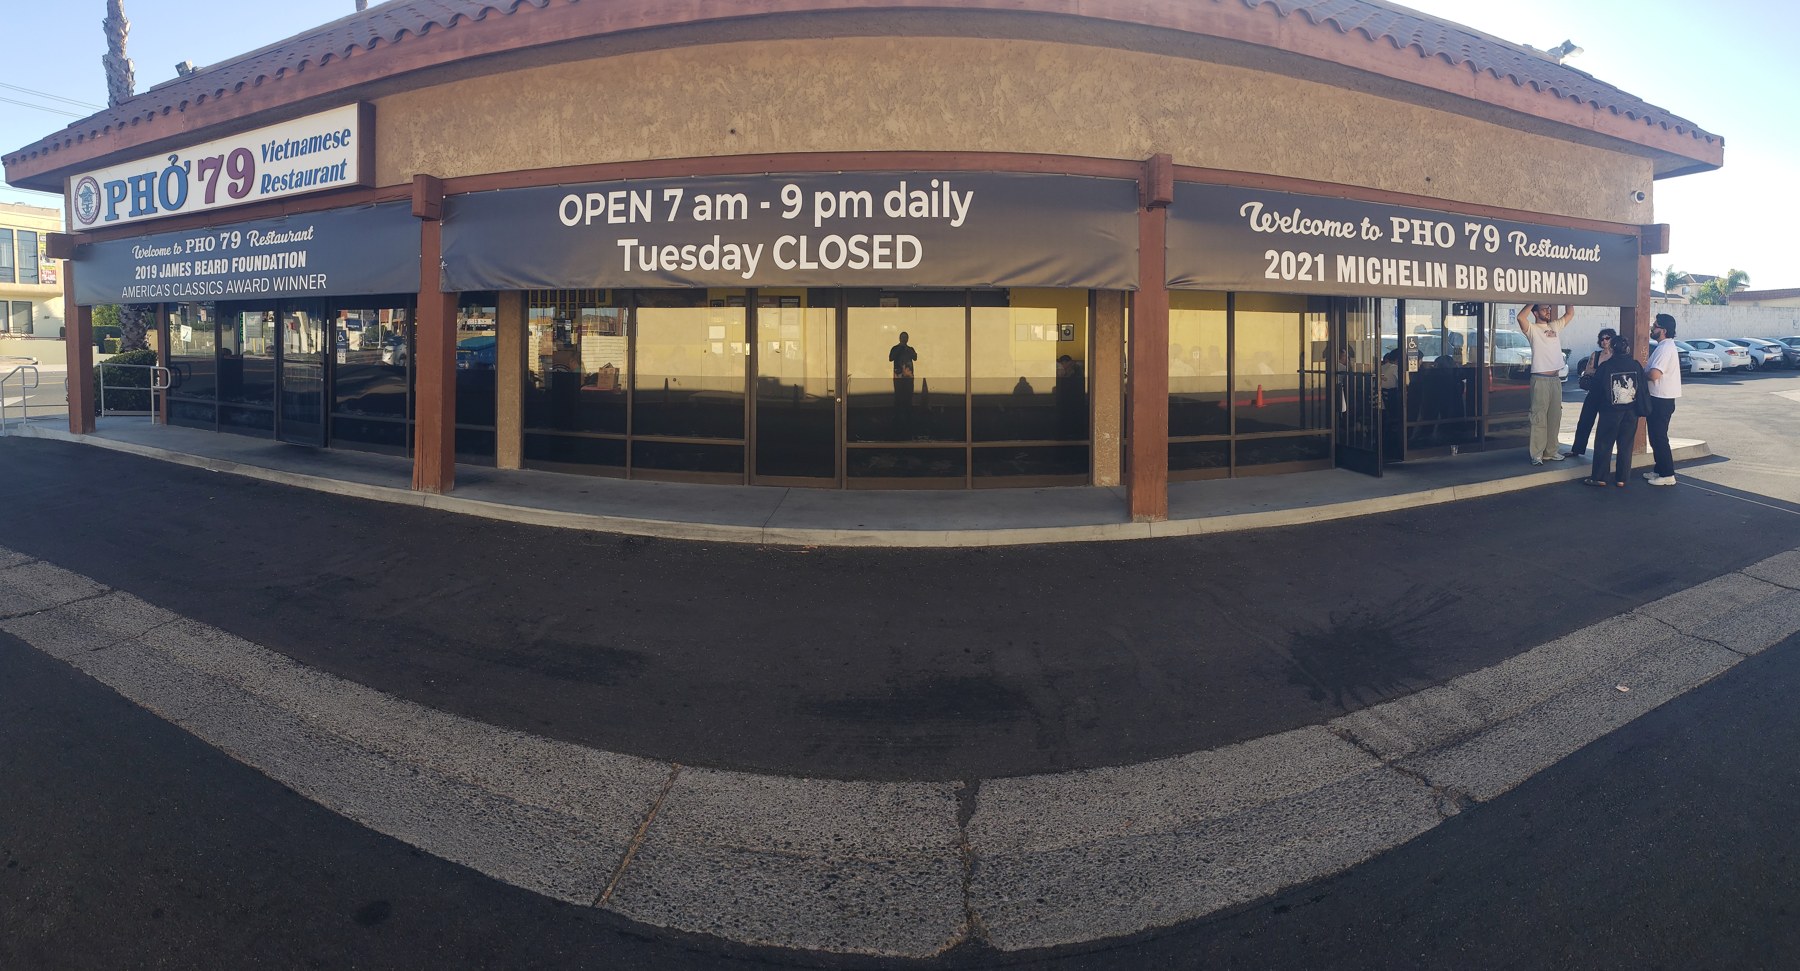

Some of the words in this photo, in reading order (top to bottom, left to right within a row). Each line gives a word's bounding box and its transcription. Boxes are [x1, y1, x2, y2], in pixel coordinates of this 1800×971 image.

[261, 128, 352, 163] Vietnamese
[197, 147, 256, 205] 79
[260, 158, 348, 195] Restaurant
[558, 189, 652, 227] OPEN
[663, 188, 684, 222] 7
[692, 193, 748, 222] am
[780, 183, 803, 220] 9
[814, 190, 873, 228] pm
[883, 178, 974, 228] daily
[131, 244, 172, 260] Welcome
[173, 242, 183, 255] to
[185, 236, 216, 254] PHO
[219, 230, 242, 250] 79
[246, 225, 314, 248] Restaurant
[1239, 201, 1357, 241] Welcome
[1360, 216, 1384, 241] to
[1389, 216, 1456, 249] PHO
[1464, 221, 1500, 253] 79
[1507, 230, 1601, 263] Restaurant
[135, 264, 158, 280] 2019
[159, 261, 192, 279] JAMES
[194, 259, 229, 276] BEARD
[231, 250, 307, 274] FOUNDATION
[617, 233, 764, 280] Tuesday
[772, 234, 923, 271] CLOSED
[1264, 249, 1325, 282] 2021
[1336, 254, 1448, 289] MICHELIN
[1455, 264, 1488, 291] BIB
[1493, 267, 1589, 296] GOURMAND
[121, 284, 171, 299] AMERICA'S
[172, 280, 224, 297] CLASSICS
[225, 278, 270, 294] AWARD
[272, 273, 327, 292] WINNER
